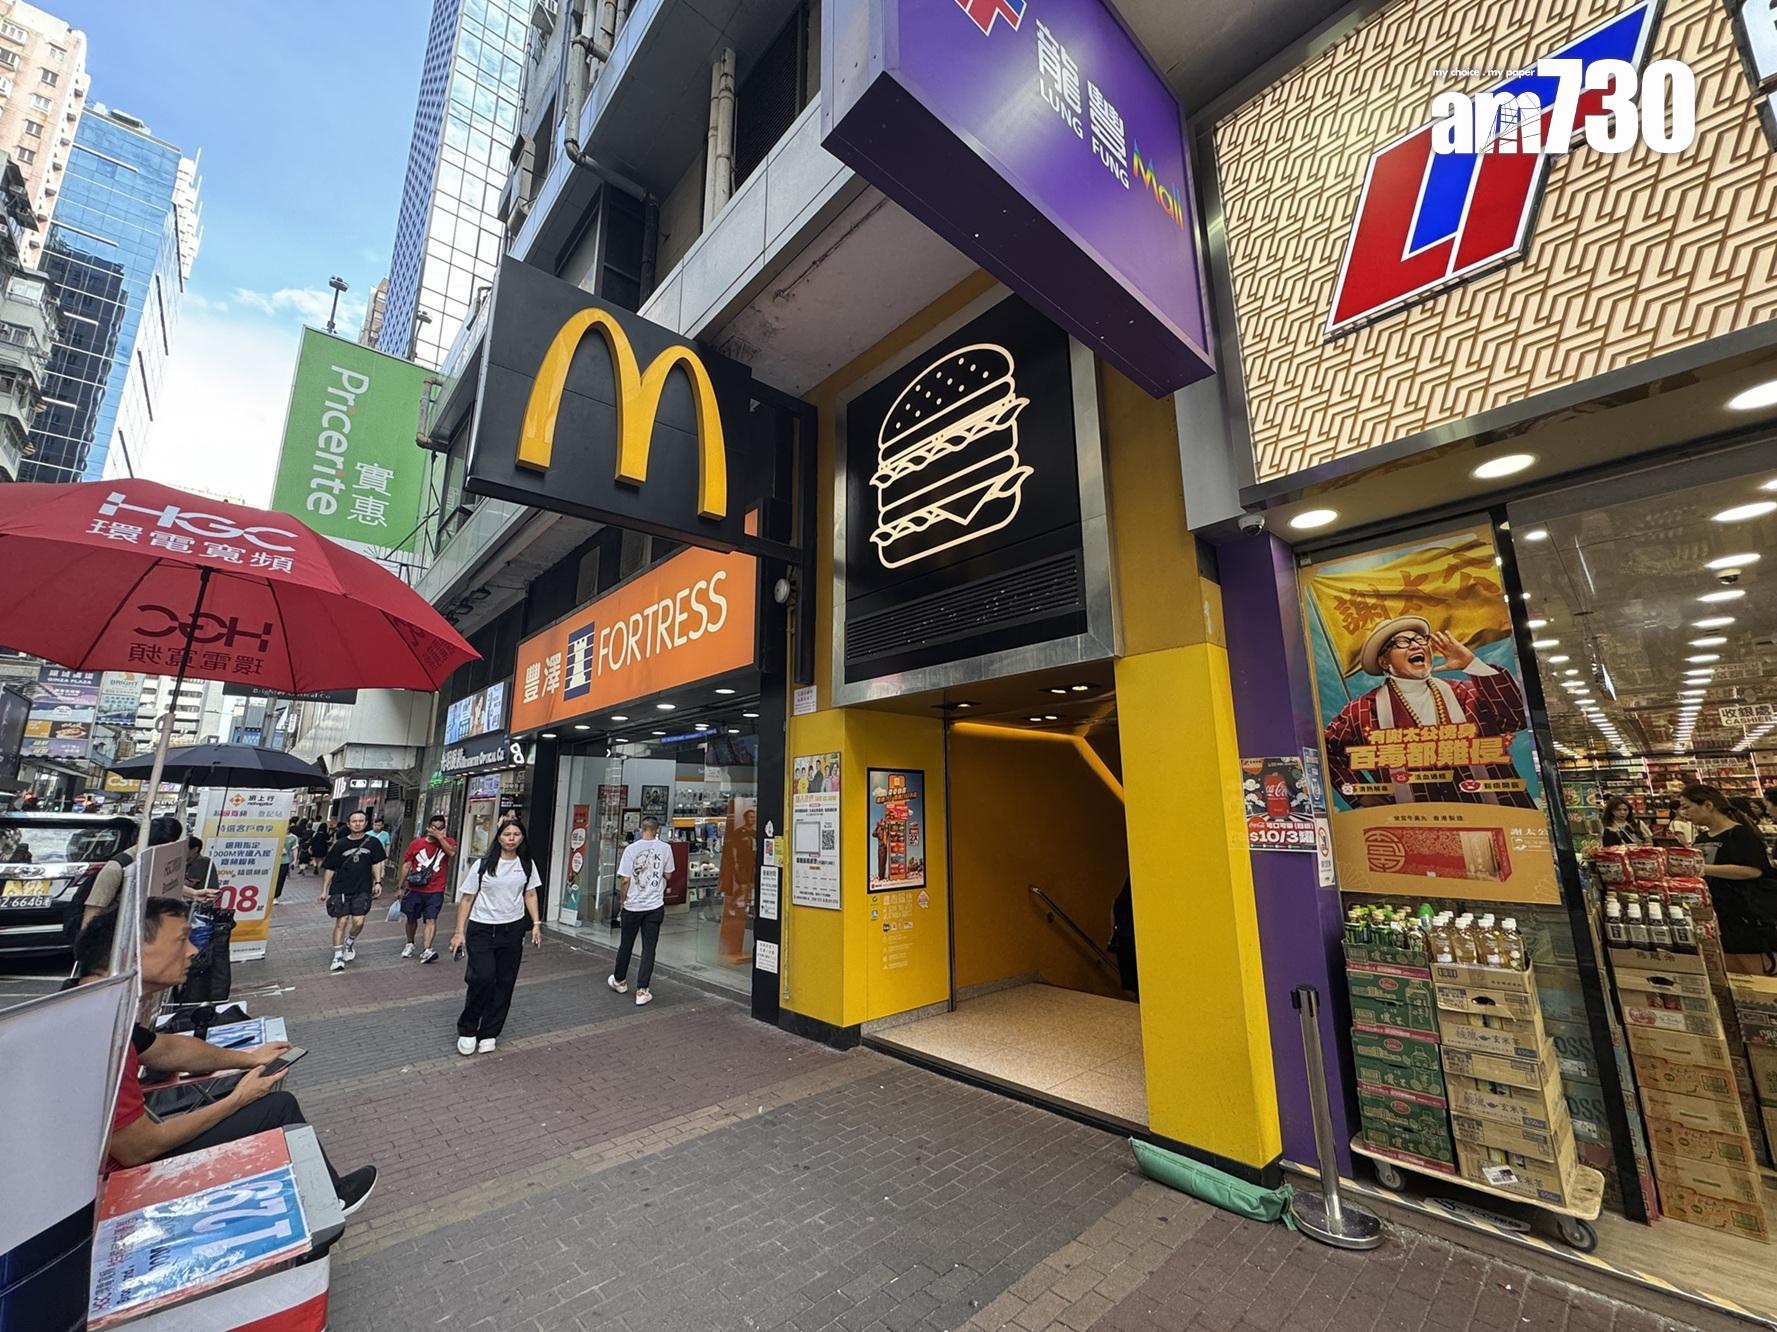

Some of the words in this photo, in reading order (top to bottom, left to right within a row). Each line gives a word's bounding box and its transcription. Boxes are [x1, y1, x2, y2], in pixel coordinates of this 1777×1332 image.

[1036, 18, 1128, 167] 龍豐
[1039, 78, 1084, 140] LUNG
[1092, 135, 1130, 190] FUNG
[1133, 137, 1184, 231] Mall
[306, 364, 370, 516] Pricerite
[98, 491, 299, 553] HGC
[347, 462, 395, 528] 實惠
[85, 518, 295, 575] 環電寬頻
[596, 570, 728, 677] FORTRESS
[523, 650, 562, 704] 豐澤
[1725, 716, 1773, 725] CASHIER
[1345, 737, 1512, 770] 百毒都難侵
[651, 853, 662, 888] KURO
